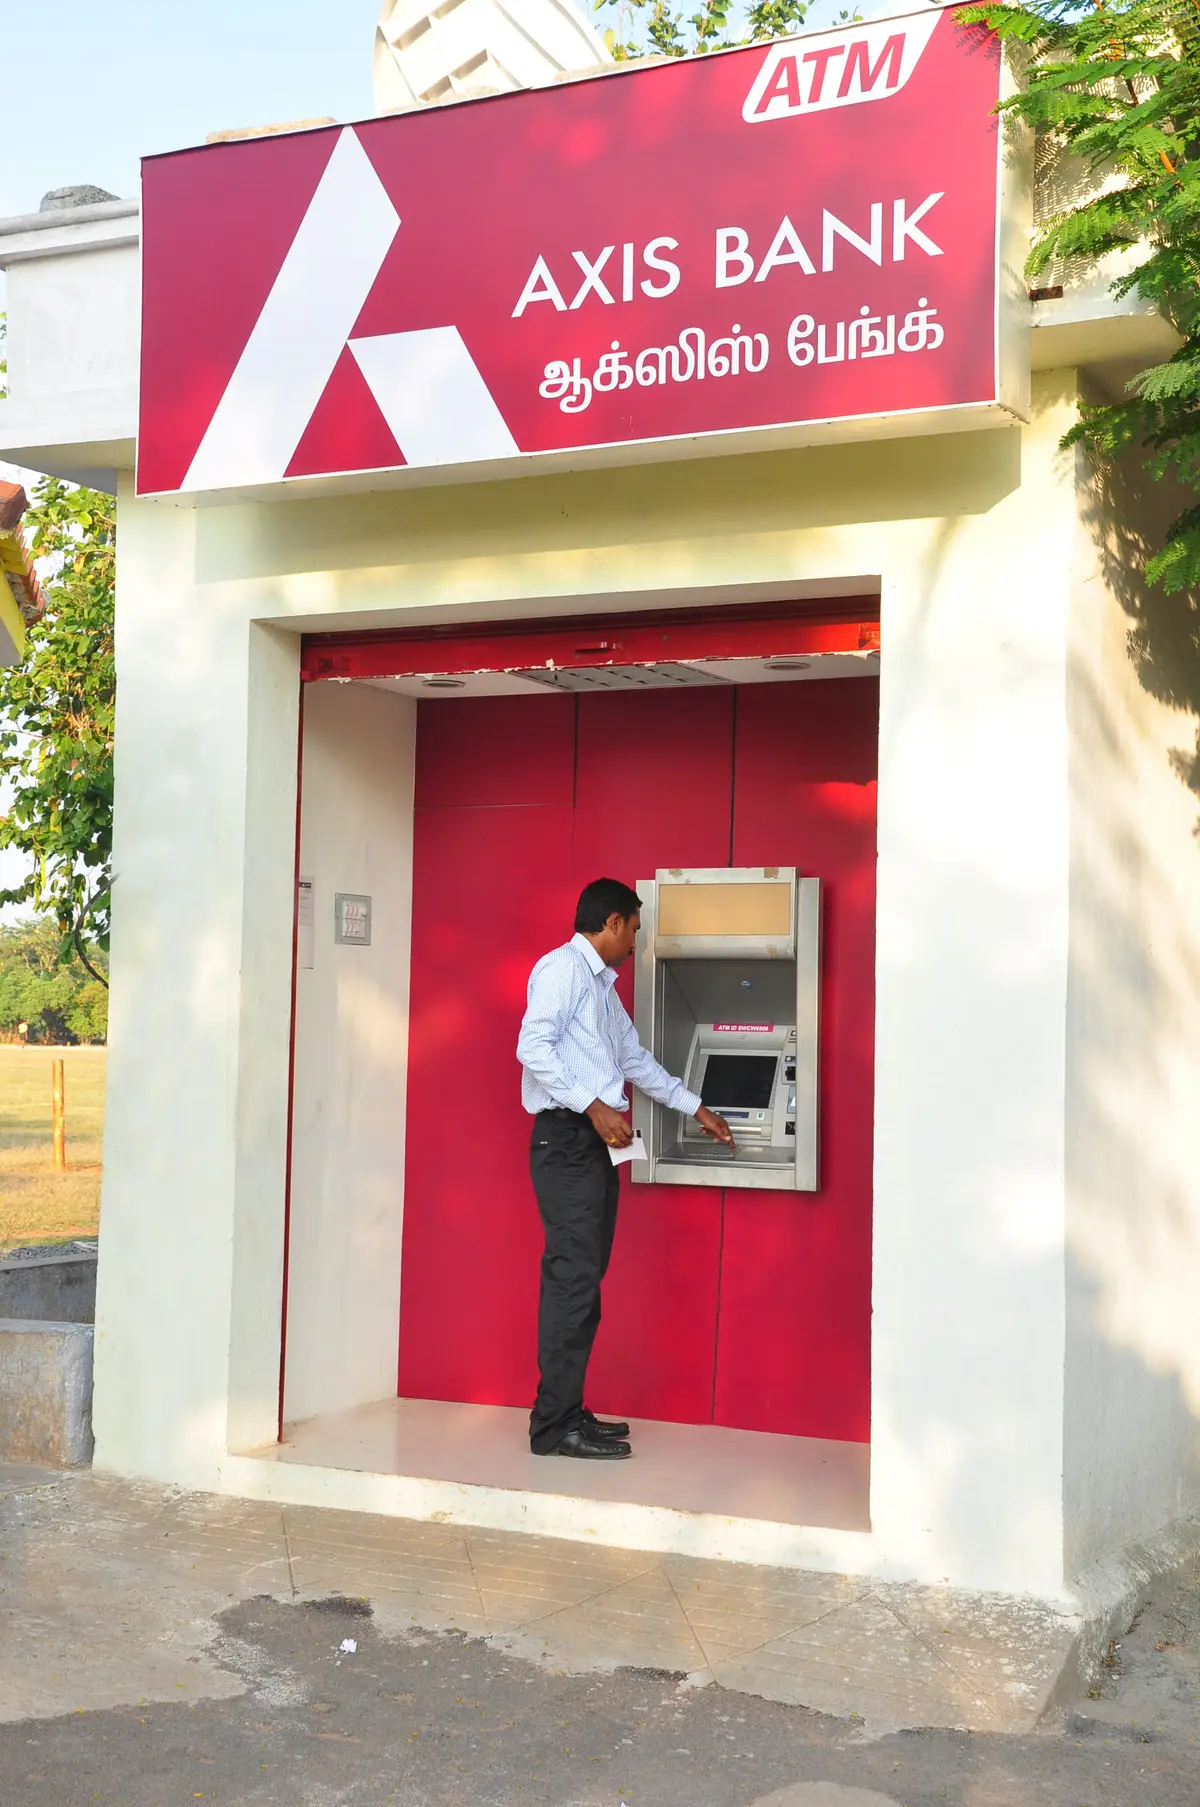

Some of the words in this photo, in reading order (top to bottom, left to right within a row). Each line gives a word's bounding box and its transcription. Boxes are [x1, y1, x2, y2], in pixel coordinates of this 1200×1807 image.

[754, 33, 906, 114] ATM
[511, 237, 680, 318] AXIS
[716, 192, 945, 288] BANK
[538, 323, 769, 413] ஆக்ஸிஸ்
[787, 297, 945, 367] பேங்க்
